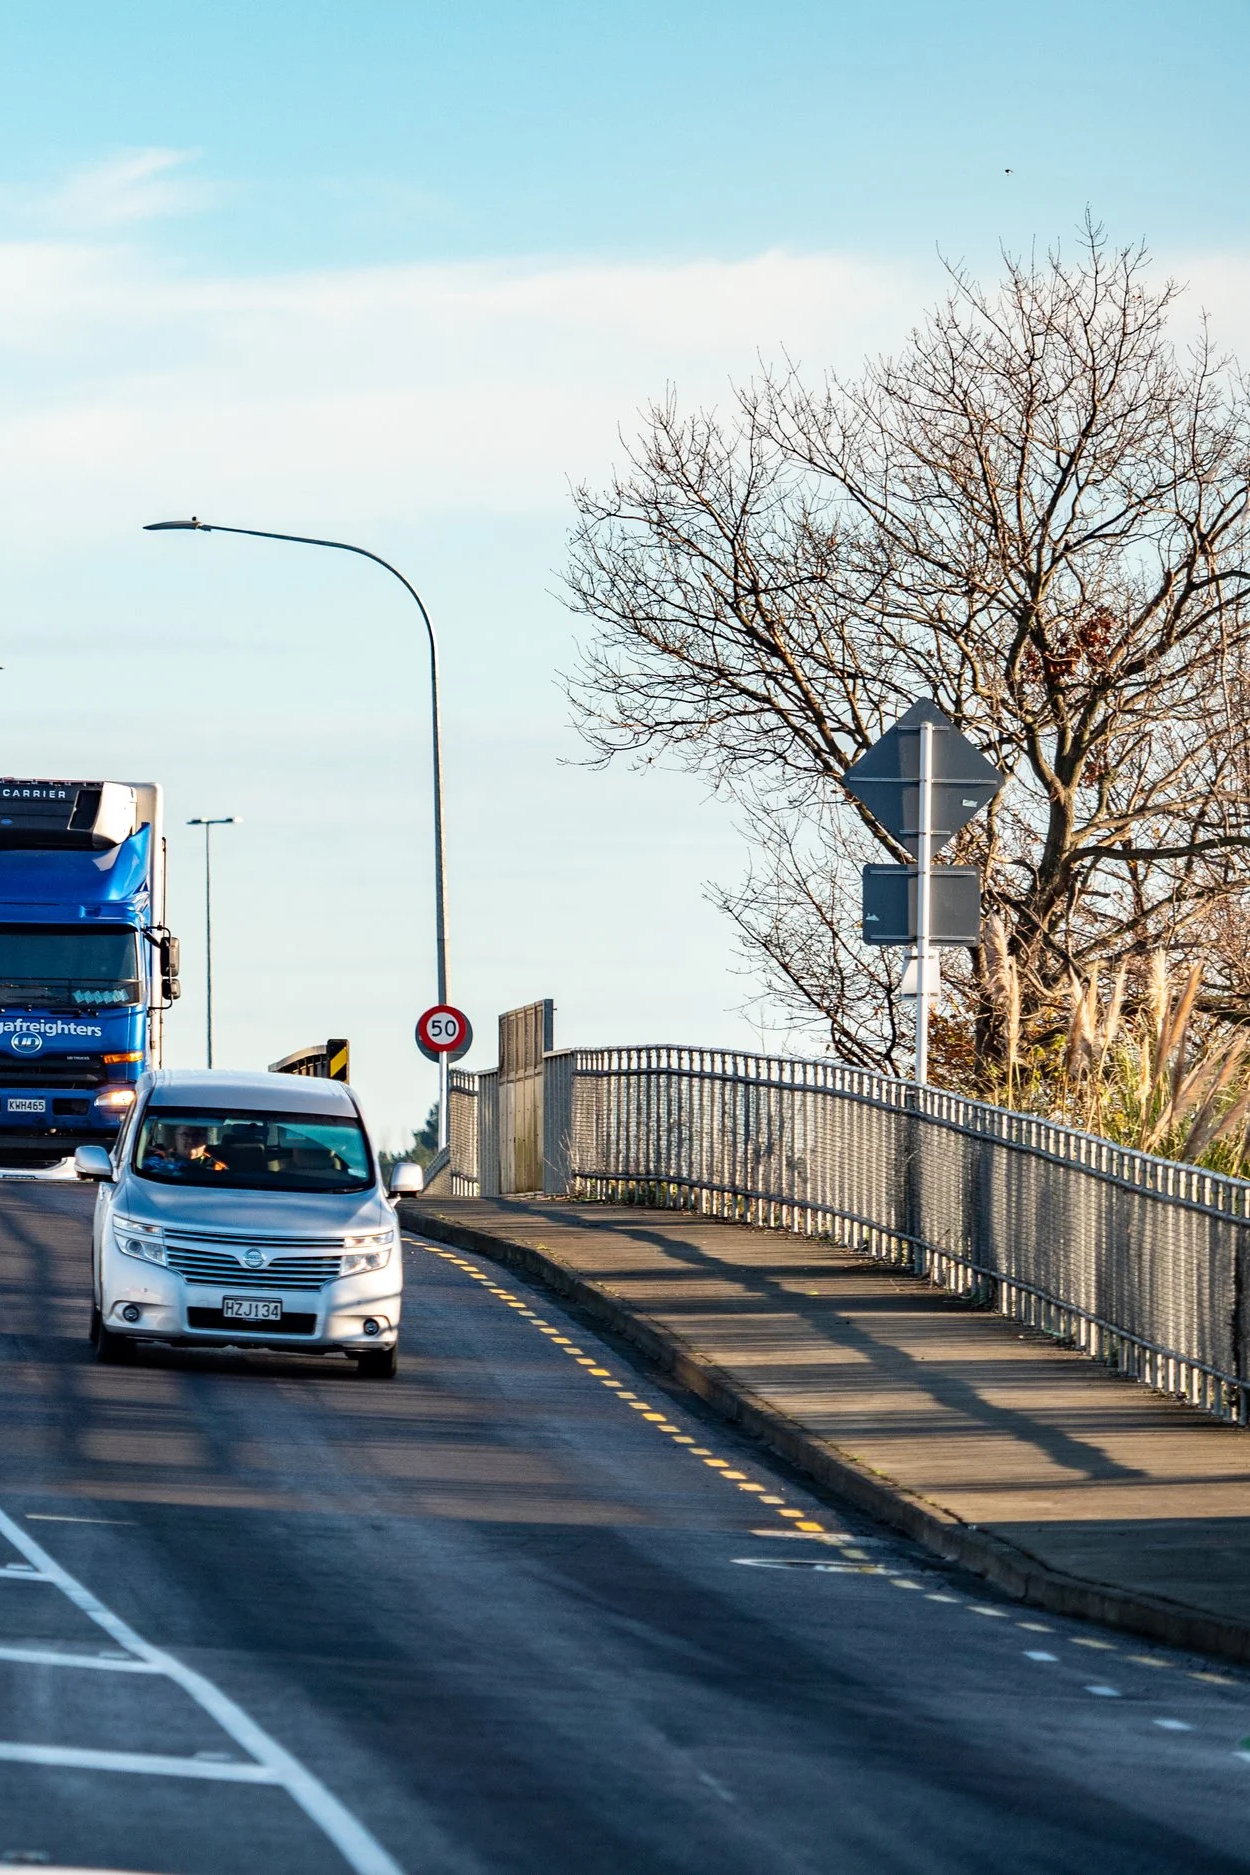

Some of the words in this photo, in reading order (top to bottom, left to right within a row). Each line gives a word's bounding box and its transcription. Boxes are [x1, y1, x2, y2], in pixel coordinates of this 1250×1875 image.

[2, 789, 66, 798] CARRIER
[431, 1020, 457, 1037] 50
[9, 1100, 45, 1111] KWH465
[225, 1302, 279, 1318] HZJ134
